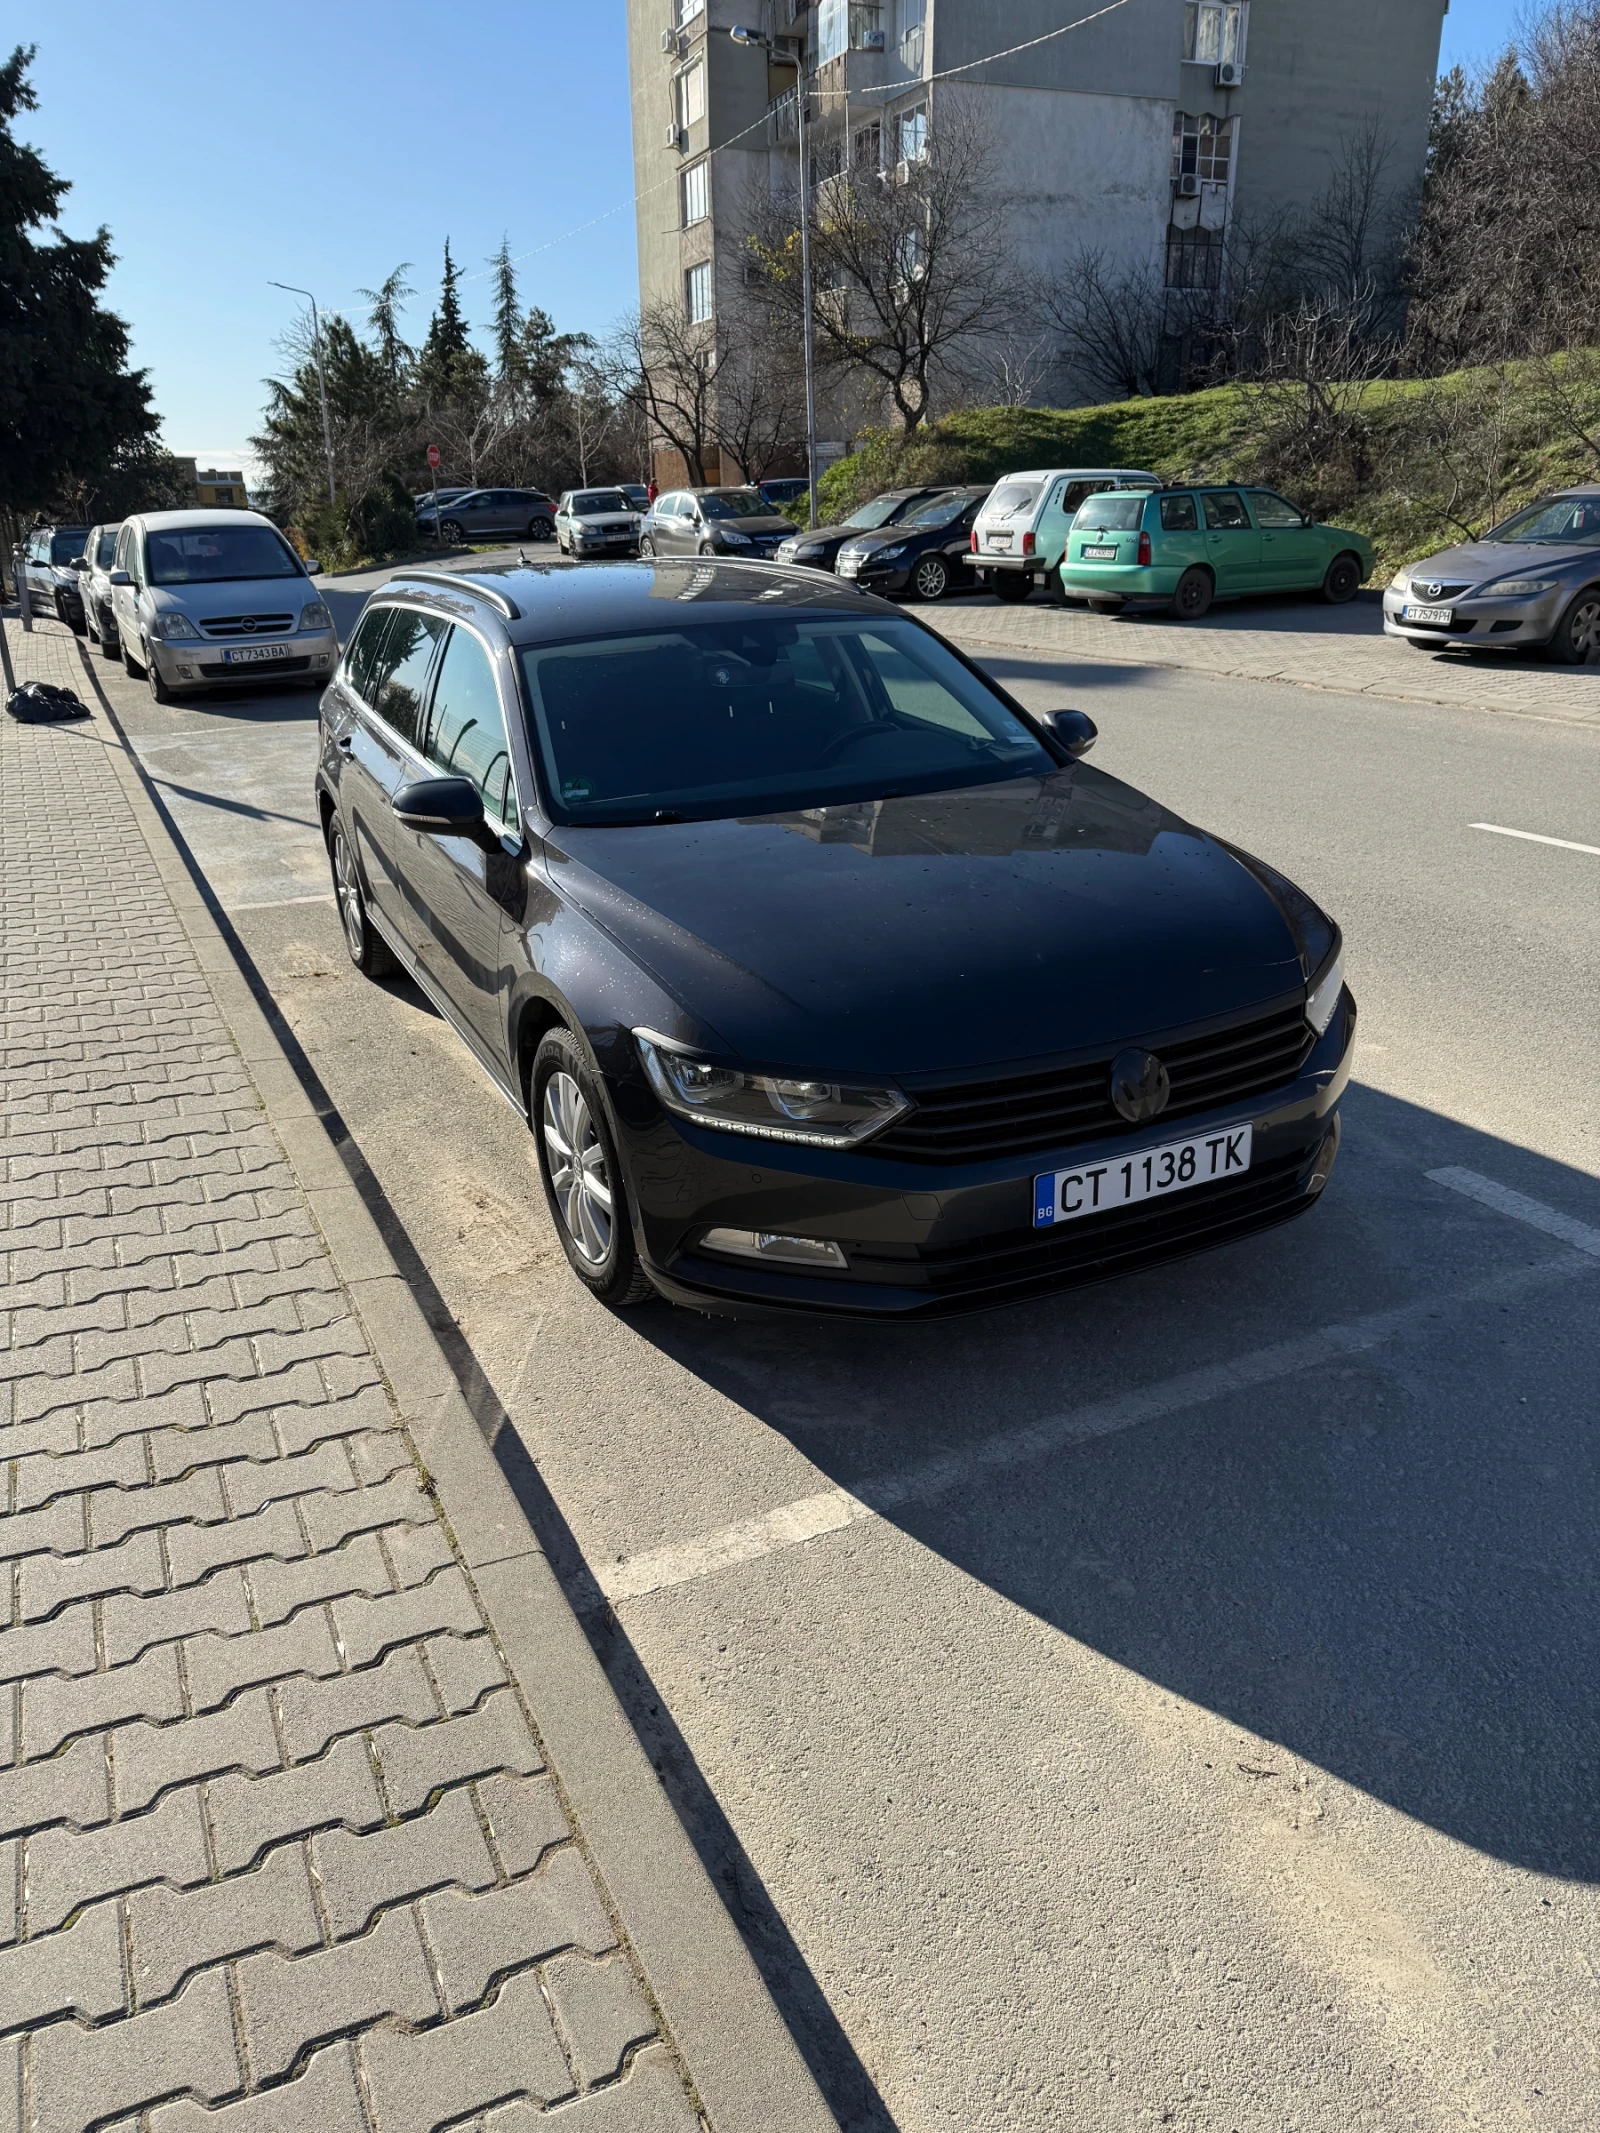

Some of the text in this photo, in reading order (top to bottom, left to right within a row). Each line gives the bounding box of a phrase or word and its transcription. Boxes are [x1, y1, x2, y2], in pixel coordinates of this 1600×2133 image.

[428, 452, 439, 461] STOP
[1407, 608, 1451, 621] CT 7579 PH
[231, 646, 285, 662] CT 7343 BA
[1060, 1131, 1245, 1213] CT 1138 TK
[1037, 1205, 1053, 1219] BG
